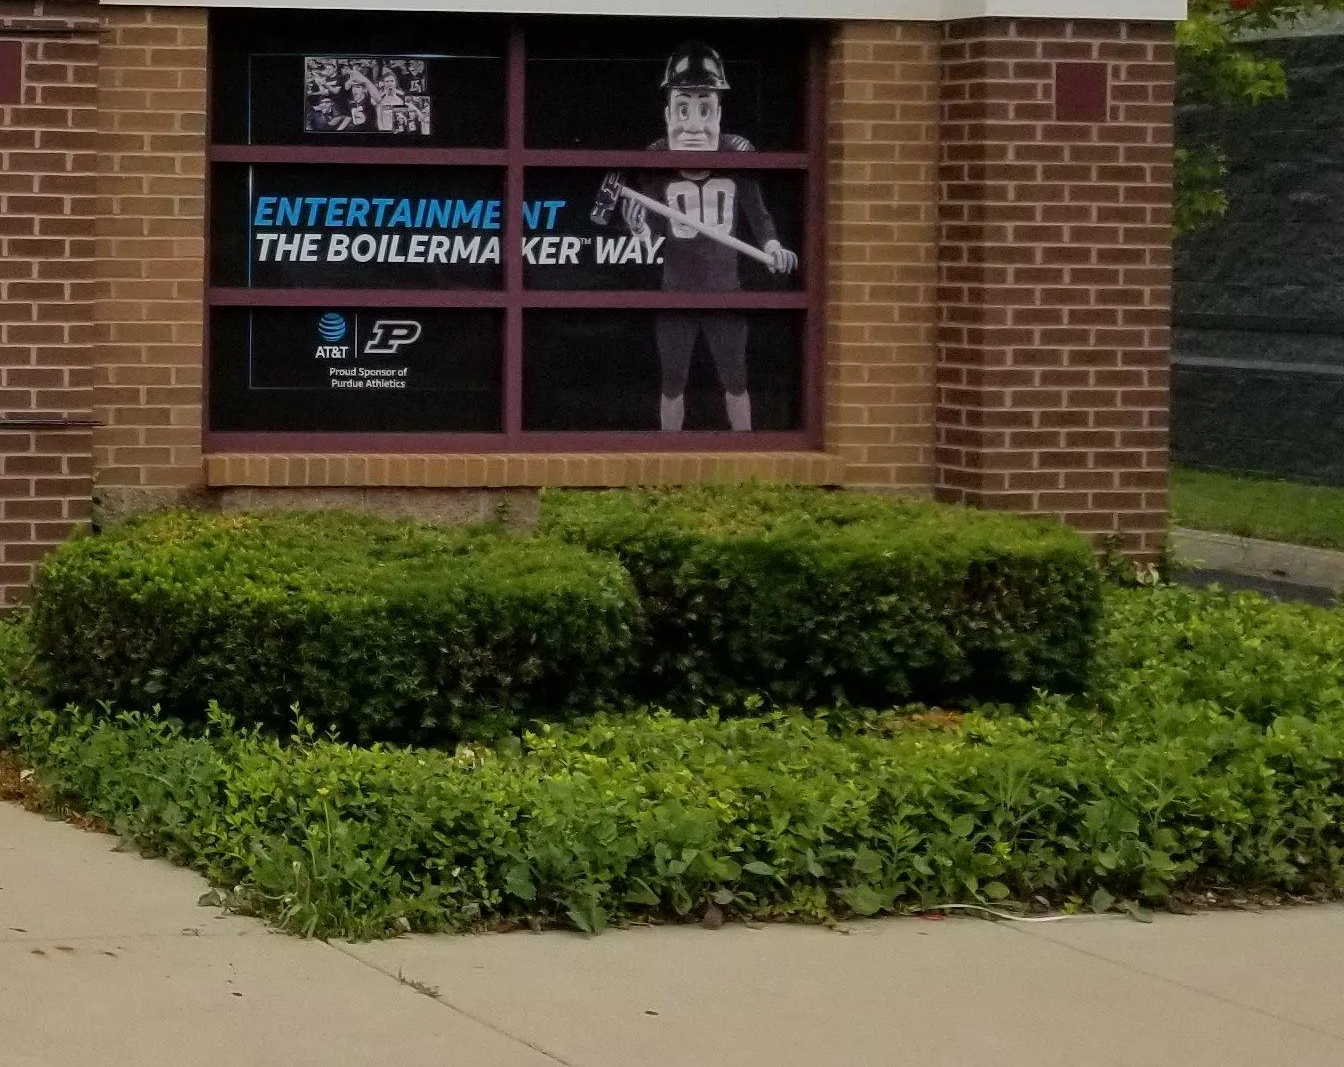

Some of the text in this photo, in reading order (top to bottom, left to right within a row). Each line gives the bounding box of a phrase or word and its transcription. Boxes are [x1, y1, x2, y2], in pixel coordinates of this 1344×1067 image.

[253, 196, 566, 230] ENTERTAINMENT
[255, 233, 322, 262] THE
[595, 236, 665, 265] WAY.
[315, 345, 349, 359] AT&T
[329, 367, 408, 378] Proud Sponsor of
[331, 379, 406, 388] Purdue Athletics
